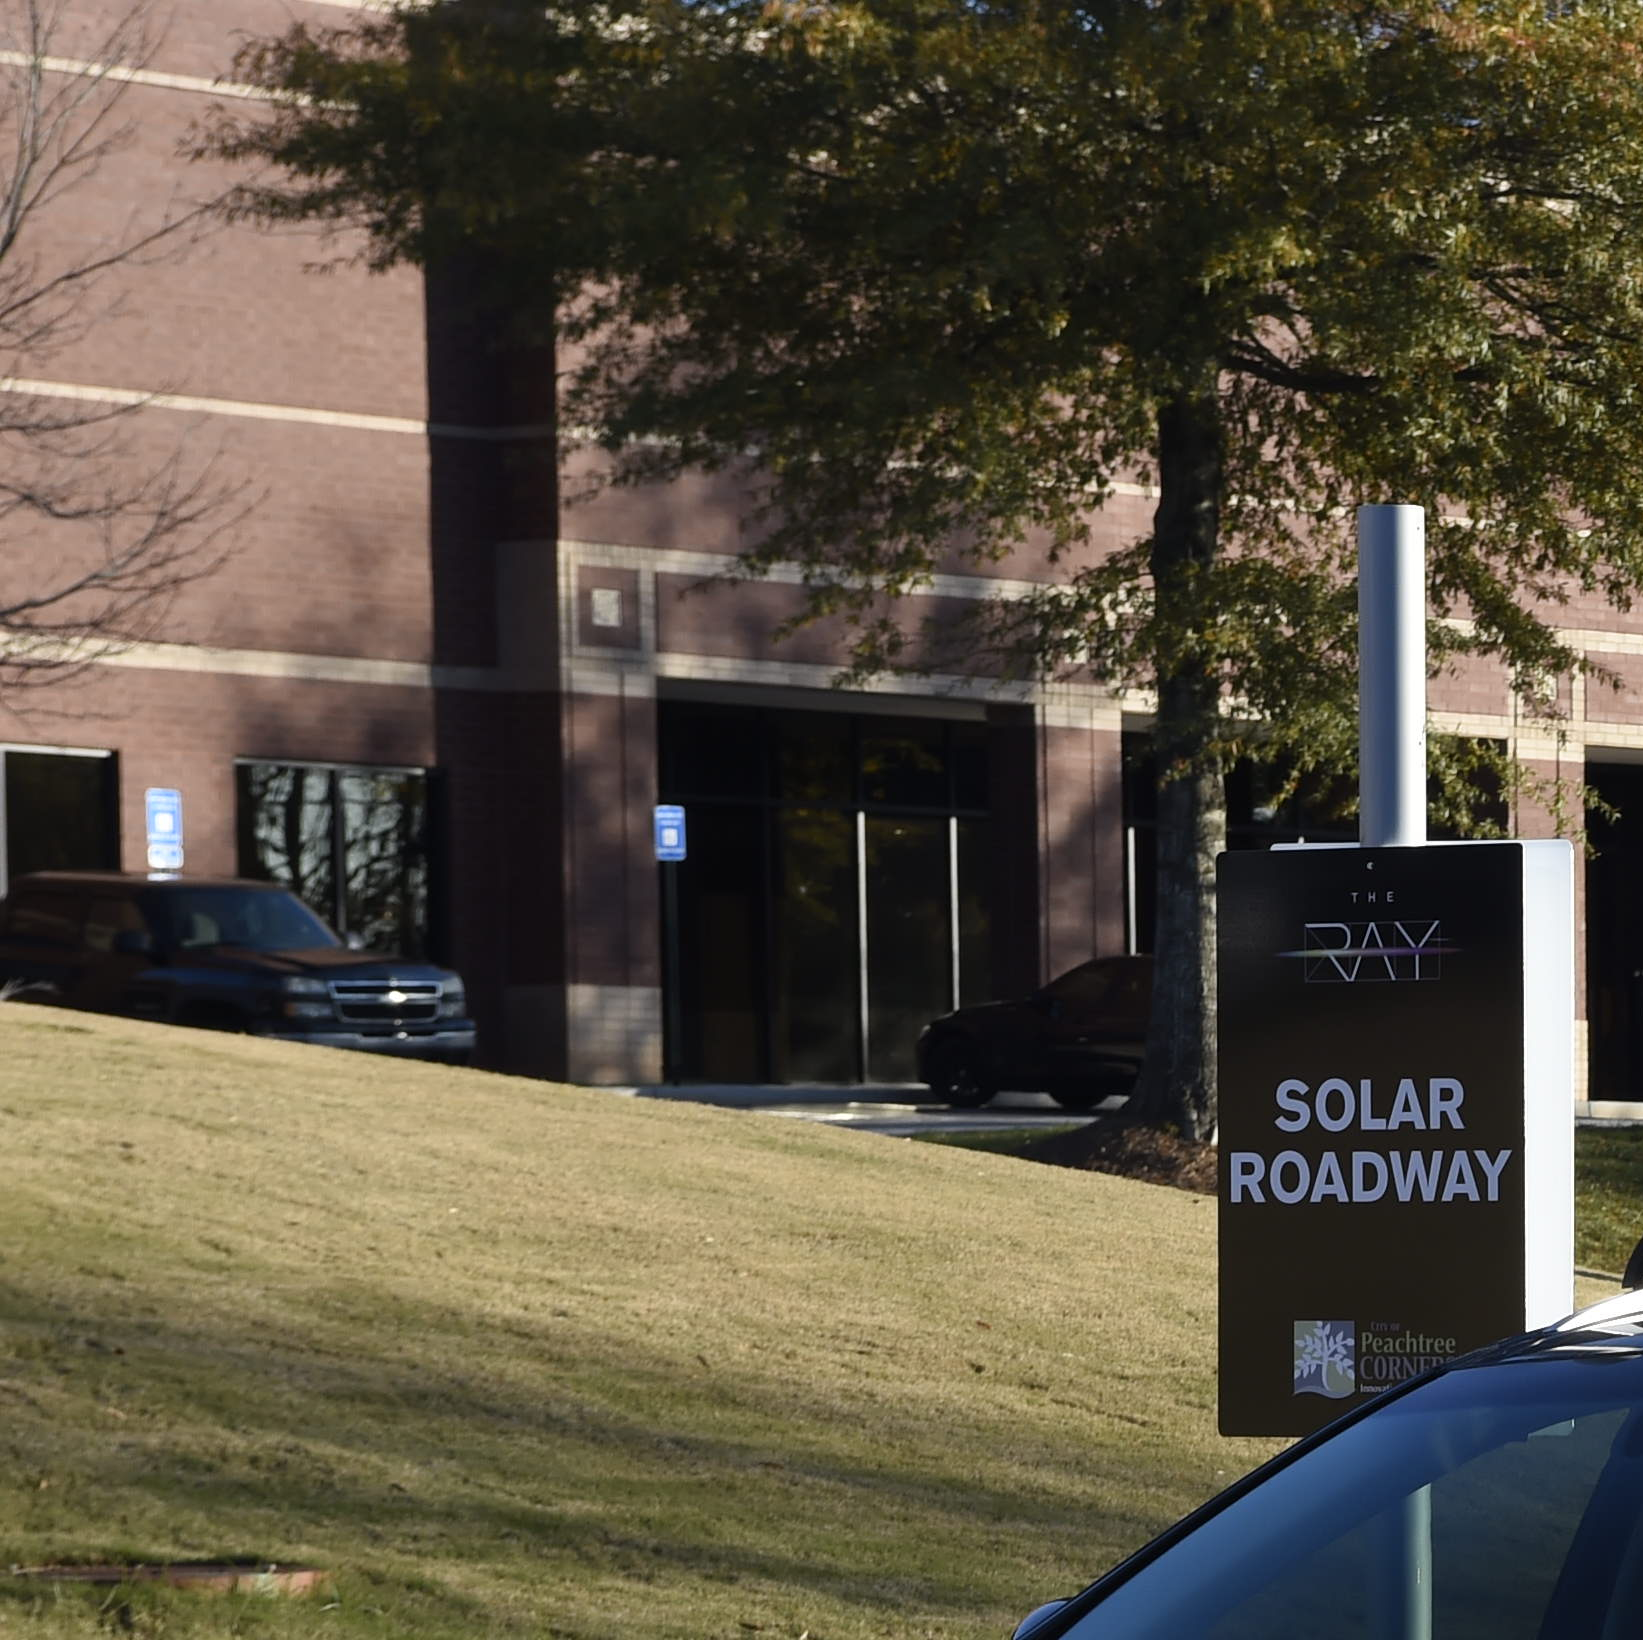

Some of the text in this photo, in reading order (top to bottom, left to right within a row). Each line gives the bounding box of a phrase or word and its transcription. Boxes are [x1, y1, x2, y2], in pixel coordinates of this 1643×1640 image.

[1351, 891, 1395, 904] THE
[1304, 920, 1440, 982] RAY
[1274, 1078, 1465, 1132] SOLAR
[1229, 1150, 1512, 1204] ROADWAY
[1361, 1330, 1457, 1353] Peachtree
